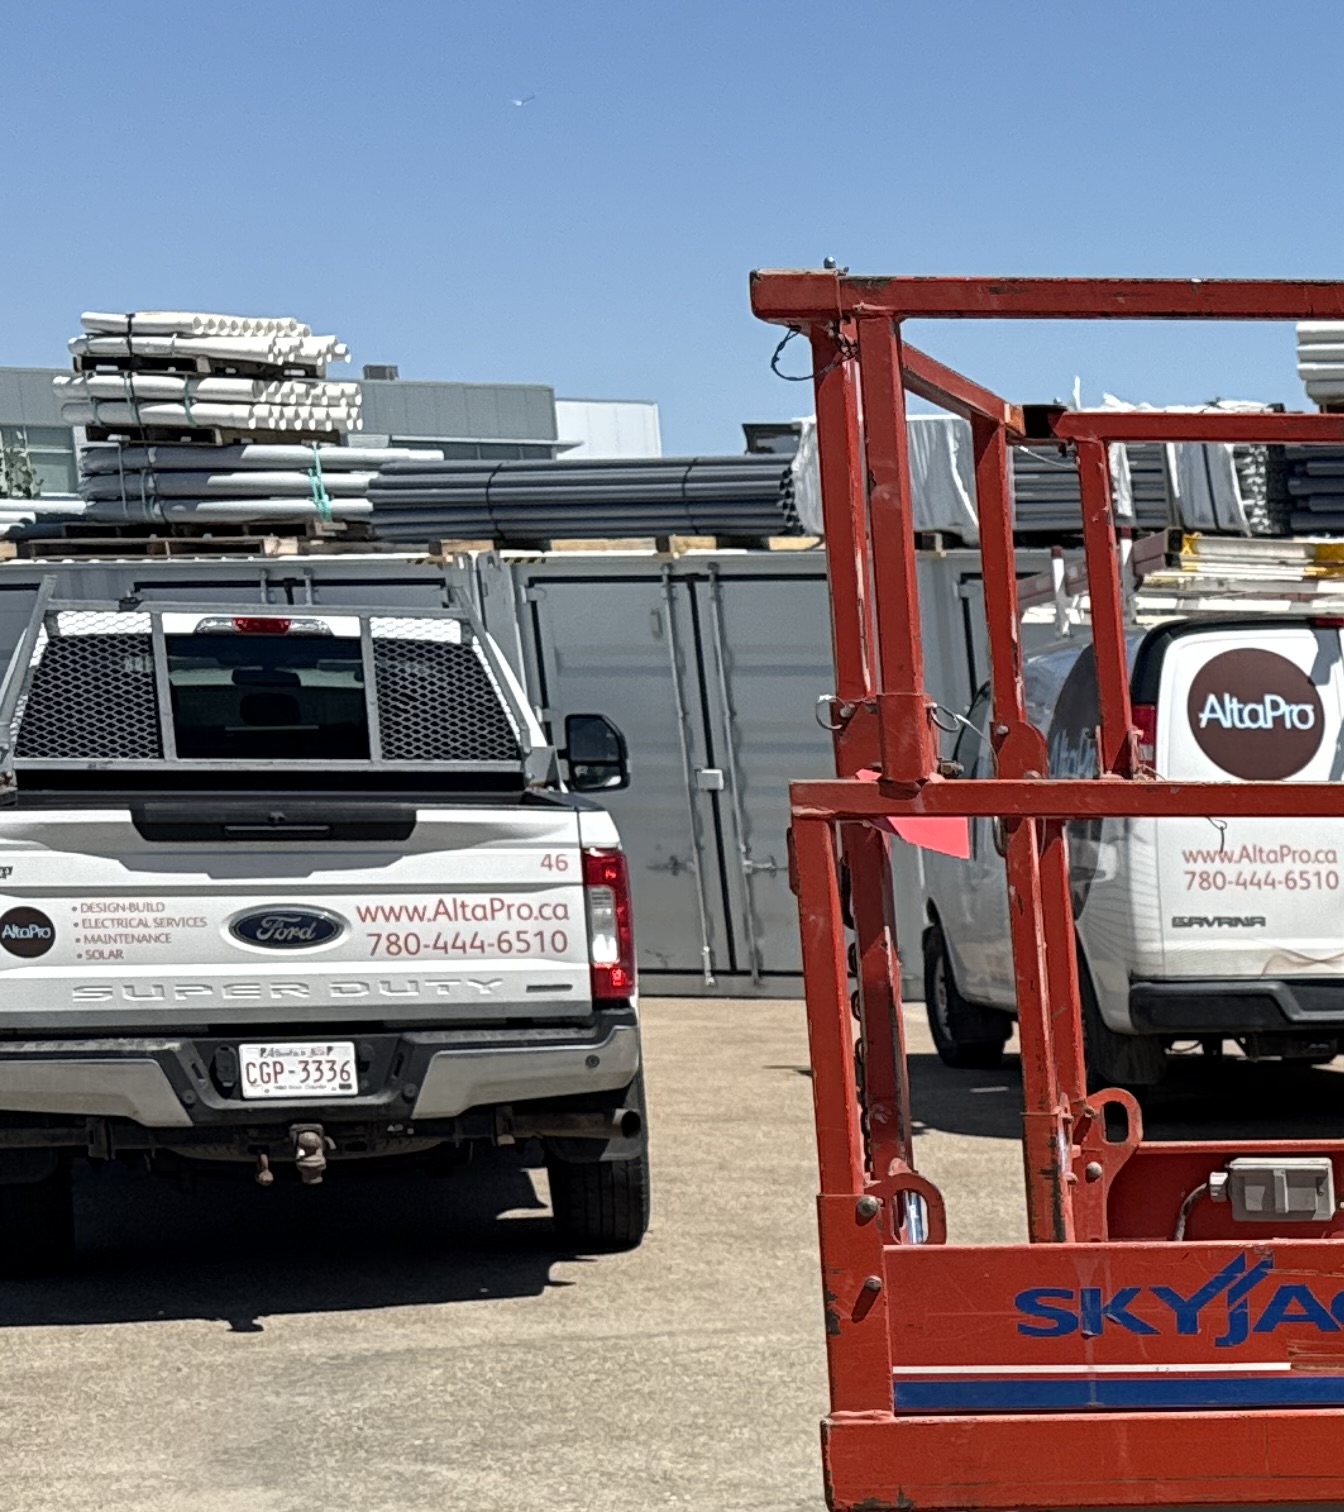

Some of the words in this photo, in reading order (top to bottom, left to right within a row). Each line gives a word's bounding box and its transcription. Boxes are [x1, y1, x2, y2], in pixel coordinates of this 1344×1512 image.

[1199, 693, 1315, 730] AltaPro
[541, 854, 569, 871] 46
[1182, 844, 1338, 864] www.AltaPro.ca
[1184, 870, 1339, 891] 780-444-6510
[356, 898, 570, 923] www.AltaPro.ca
[2, 924, 51, 940] AltaPro
[82, 917, 150, 929] ELECTRICAL
[153, 916, 208, 928] SERVICES
[256, 916, 316, 941] Ford
[83, 932, 172, 944] MAINTENANCE
[366, 930, 568, 957] 780-444-6510
[85, 949, 124, 960] SOLAR
[72, 981, 310, 1001] SUPER
[329, 977, 503, 998] DUTY
[246, 1060, 350, 1084] CGP-3336
